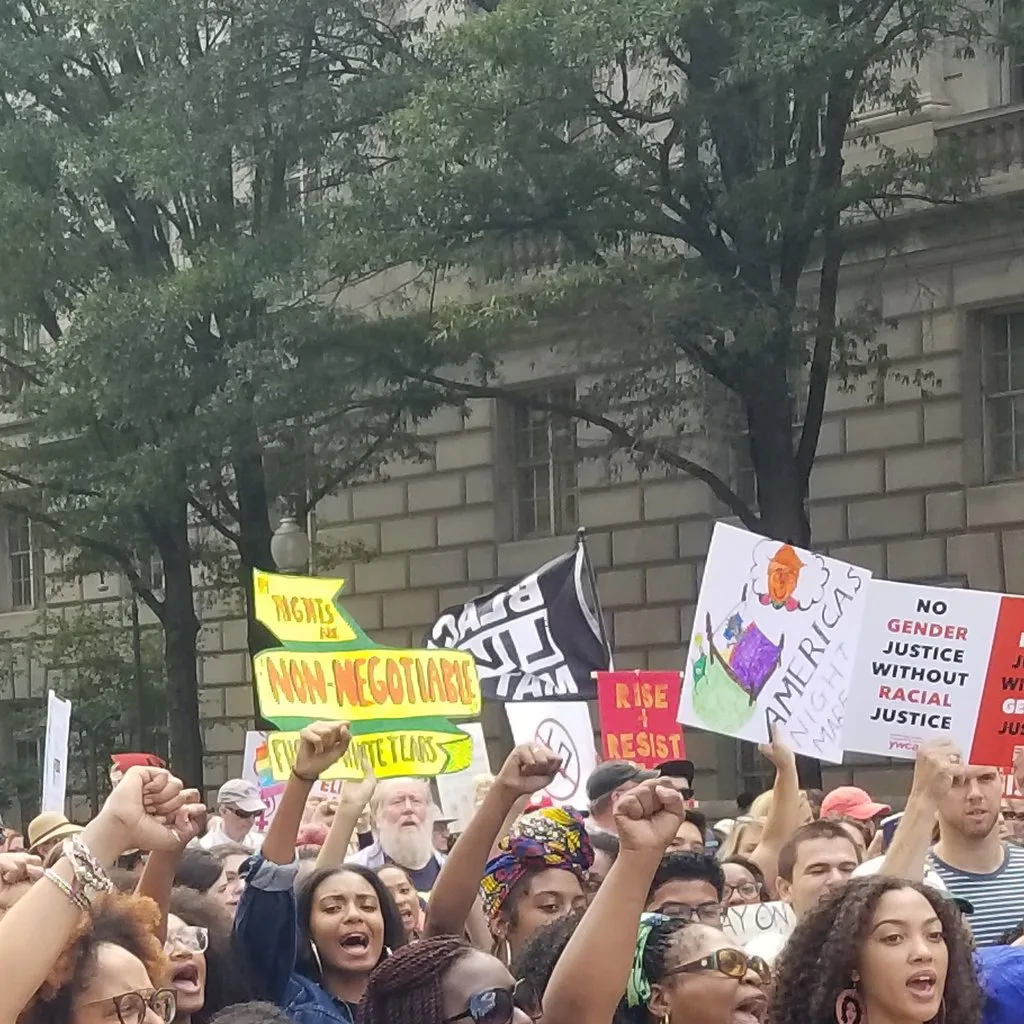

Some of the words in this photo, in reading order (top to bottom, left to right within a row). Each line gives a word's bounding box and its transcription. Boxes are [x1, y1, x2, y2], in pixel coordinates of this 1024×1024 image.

[916, 598, 947, 615] NO
[887, 618, 969, 641] GENDER
[764, 567, 863, 744] AMERICAS
[882, 641, 965, 663] JUSTICE
[266, 656, 476, 707] NON-NEGOTIABLE
[872, 661, 969, 686] WITHOUT
[616, 683, 668, 709] RISE
[790, 642, 851, 748] NIGHT
[878, 685, 952, 707] RACIAL
[870, 707, 952, 730] JUSTICE
[387, 734, 438, 764] TEARS
[607, 731, 681, 759] RESIST
